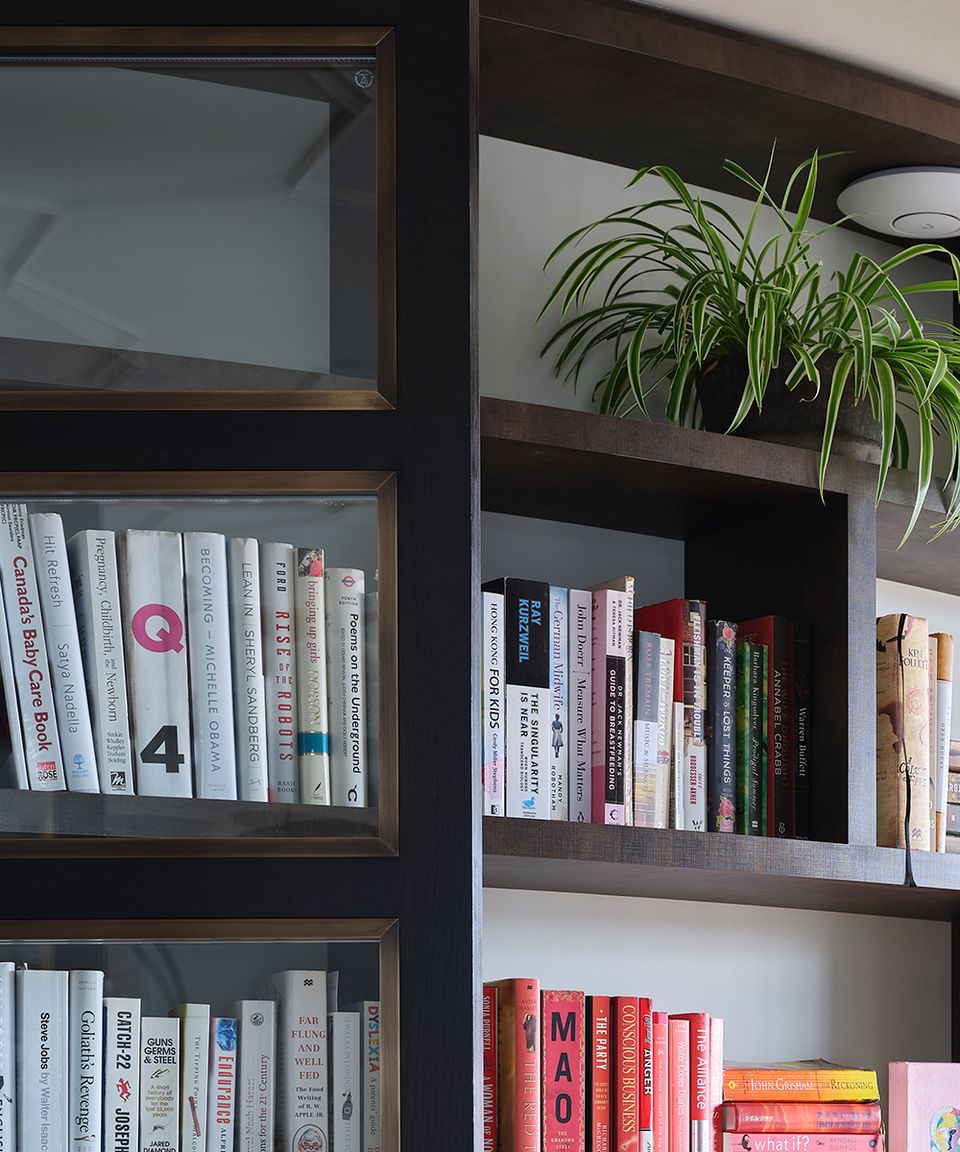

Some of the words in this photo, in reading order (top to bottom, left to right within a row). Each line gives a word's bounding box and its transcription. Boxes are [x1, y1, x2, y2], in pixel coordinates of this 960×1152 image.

[43, 535, 56, 555] Hit
[46, 559, 64, 608] Refresh
[94, 537, 108, 596] Pregnancy,
[241, 562, 253, 598] LEAN
[12, 555, 36, 625] Canada's
[200, 548, 214, 624] BECOMING
[304, 580, 319, 624] bringing
[243, 603, 254, 617] IN
[490, 603, 498, 634] HONG
[531, 600, 542, 626] RAY
[576, 604, 587, 631] John
[100, 600, 115, 656] Childbirth,
[131, 603, 184, 654] Q
[275, 611, 291, 657] RISE
[306, 626, 317, 640] up
[350, 613, 360, 651] Poems
[518, 598, 529, 664] KURZWEIL
[553, 610, 564, 659] German
[693, 614, 702, 669] FLEISHMAN
[22, 629, 40, 667] Baby
[57, 643, 72, 679] Satya
[110, 658, 118, 670] and
[245, 629, 257, 682] SHERYL
[306, 642, 321, 664] girls
[350, 655, 359, 670] on
[490, 636, 498, 666] KONG
[577, 635, 587, 667] Doerr
[908, 648, 923, 658] KEN
[206, 644, 219, 714] MICHELLE
[279, 663, 290, 672] OF
[350, 673, 360, 693] the
[489, 668, 500, 696] FOR
[609, 669, 617, 699] GUIDE
[722, 656, 732, 699] KEEPER
[752, 651, 760, 684] Barbara
[29, 669, 44, 708] Care
[105, 672, 119, 722] Newborn
[520, 692, 529, 703] IS
[530, 693, 539, 715] THE
[553, 663, 564, 711] Midwife
[576, 679, 587, 724] Measure
[773, 669, 782, 729] ANNABEL
[63, 684, 80, 734] Nadella
[489, 698, 500, 729] KIDS
[520, 708, 529, 737] NEAR
[609, 700, 617, 713] TO
[693, 701, 702, 743] TROUBLE
[751, 687, 760, 730] Kingsolver
[798, 706, 807, 742] Warren
[34, 711, 53, 752] Book
[247, 687, 260, 762] SANDBERG
[277, 691, 294, 761] ROBOTS
[349, 697, 362, 774] Underground
[722, 711, 731, 738] LOST
[140, 725, 185, 774] 4
[208, 720, 221, 773] OBAMA
[530, 719, 539, 794] SINGULARITY
[576, 728, 586, 757] What
[608, 716, 616, 791] BREASTFEEDING
[773, 734, 782, 776] CRABB
[722, 743, 732, 784] THINGS
[798, 745, 808, 777] Buffett
[576, 761, 586, 802] Matters
[40, 1012, 51, 1042] Steve
[291, 1030, 326, 1039] FLUNG
[298, 1016, 319, 1025] FAR
[596, 1016, 608, 1035] THE
[80, 1010, 96, 1070] Goliath's
[116, 1011, 132, 1070] CATCH-22
[143, 1046, 176, 1056] GERMS
[147, 1037, 173, 1047] GUNS
[297, 1044, 320, 1052] AND
[367, 1005, 380, 1073] DYSLEXIA
[596, 1038, 608, 1071] PARTY
[621, 1005, 636, 1075] CONSCIOUS
[696, 1029, 710, 1052] The
[40, 1044, 51, 1070] Jobs
[143, 1056, 152, 1064] &
[153, 1056, 177, 1064] STEEL
[294, 1057, 324, 1066] WELL
[550, 1011, 577, 1124] MAO
[643, 1048, 652, 1095] ANGER
[39, 1072, 51, 1085] by
[299, 1071, 320, 1080] FED
[523, 1062, 537, 1094] THE
[696, 1056, 710, 1110] Alliance
[750, 1078, 774, 1091] JOHN
[775, 1077, 814, 1091] GRISHAM
[830, 1079, 874, 1090] RECKONING
[40, 1087, 51, 1122] Walter
[75, 1075, 95, 1133] Revenge
[368, 1084, 379, 1114] parents'
[483, 1084, 494, 1123] WOMAN
[621, 1077, 636, 1133] BUSINESS
[369, 1115, 379, 1136] guide
[483, 1125, 492, 1136] OF
[523, 1101, 537, 1136] RED
[755, 1135, 791, 1151] what
[792, 1135, 810, 1151] if?
